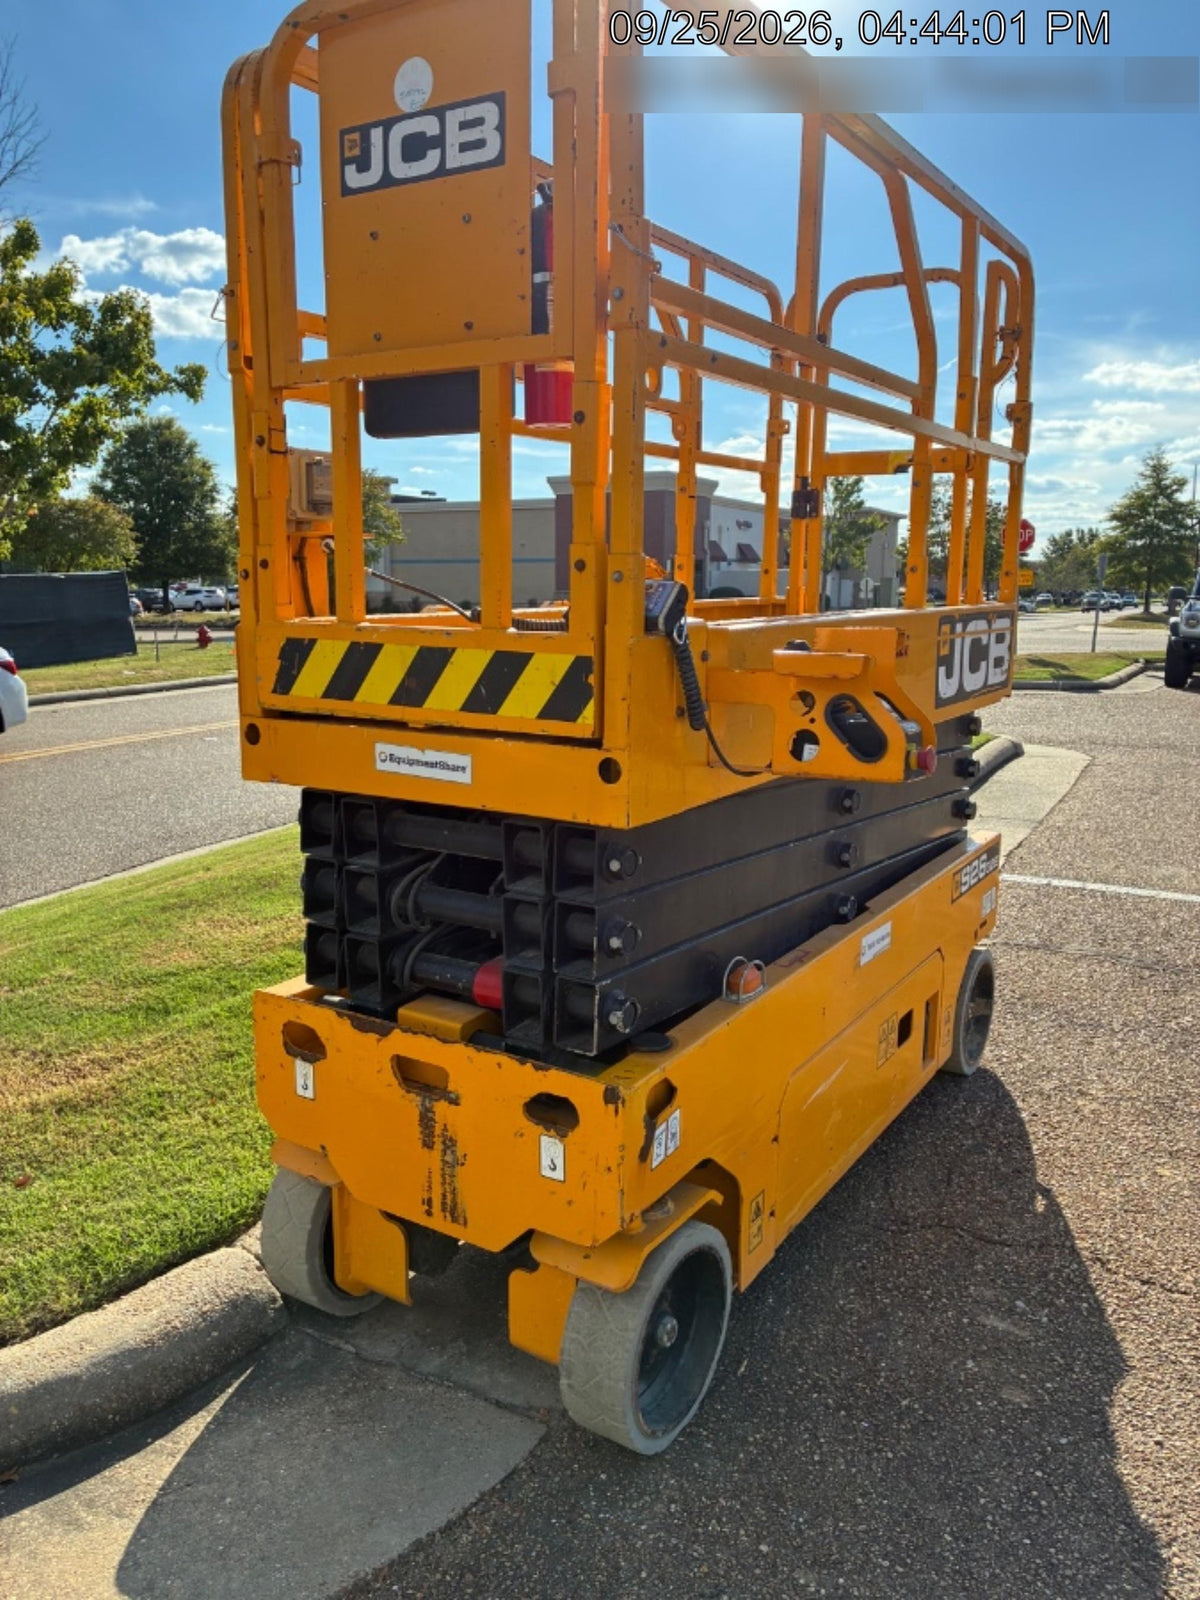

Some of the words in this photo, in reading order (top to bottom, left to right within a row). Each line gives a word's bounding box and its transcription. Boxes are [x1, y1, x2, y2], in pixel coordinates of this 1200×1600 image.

[344, 101, 501, 189] JCB
[938, 618, 1011, 699] JCB
[388, 753, 468, 774] EquipmentShare
